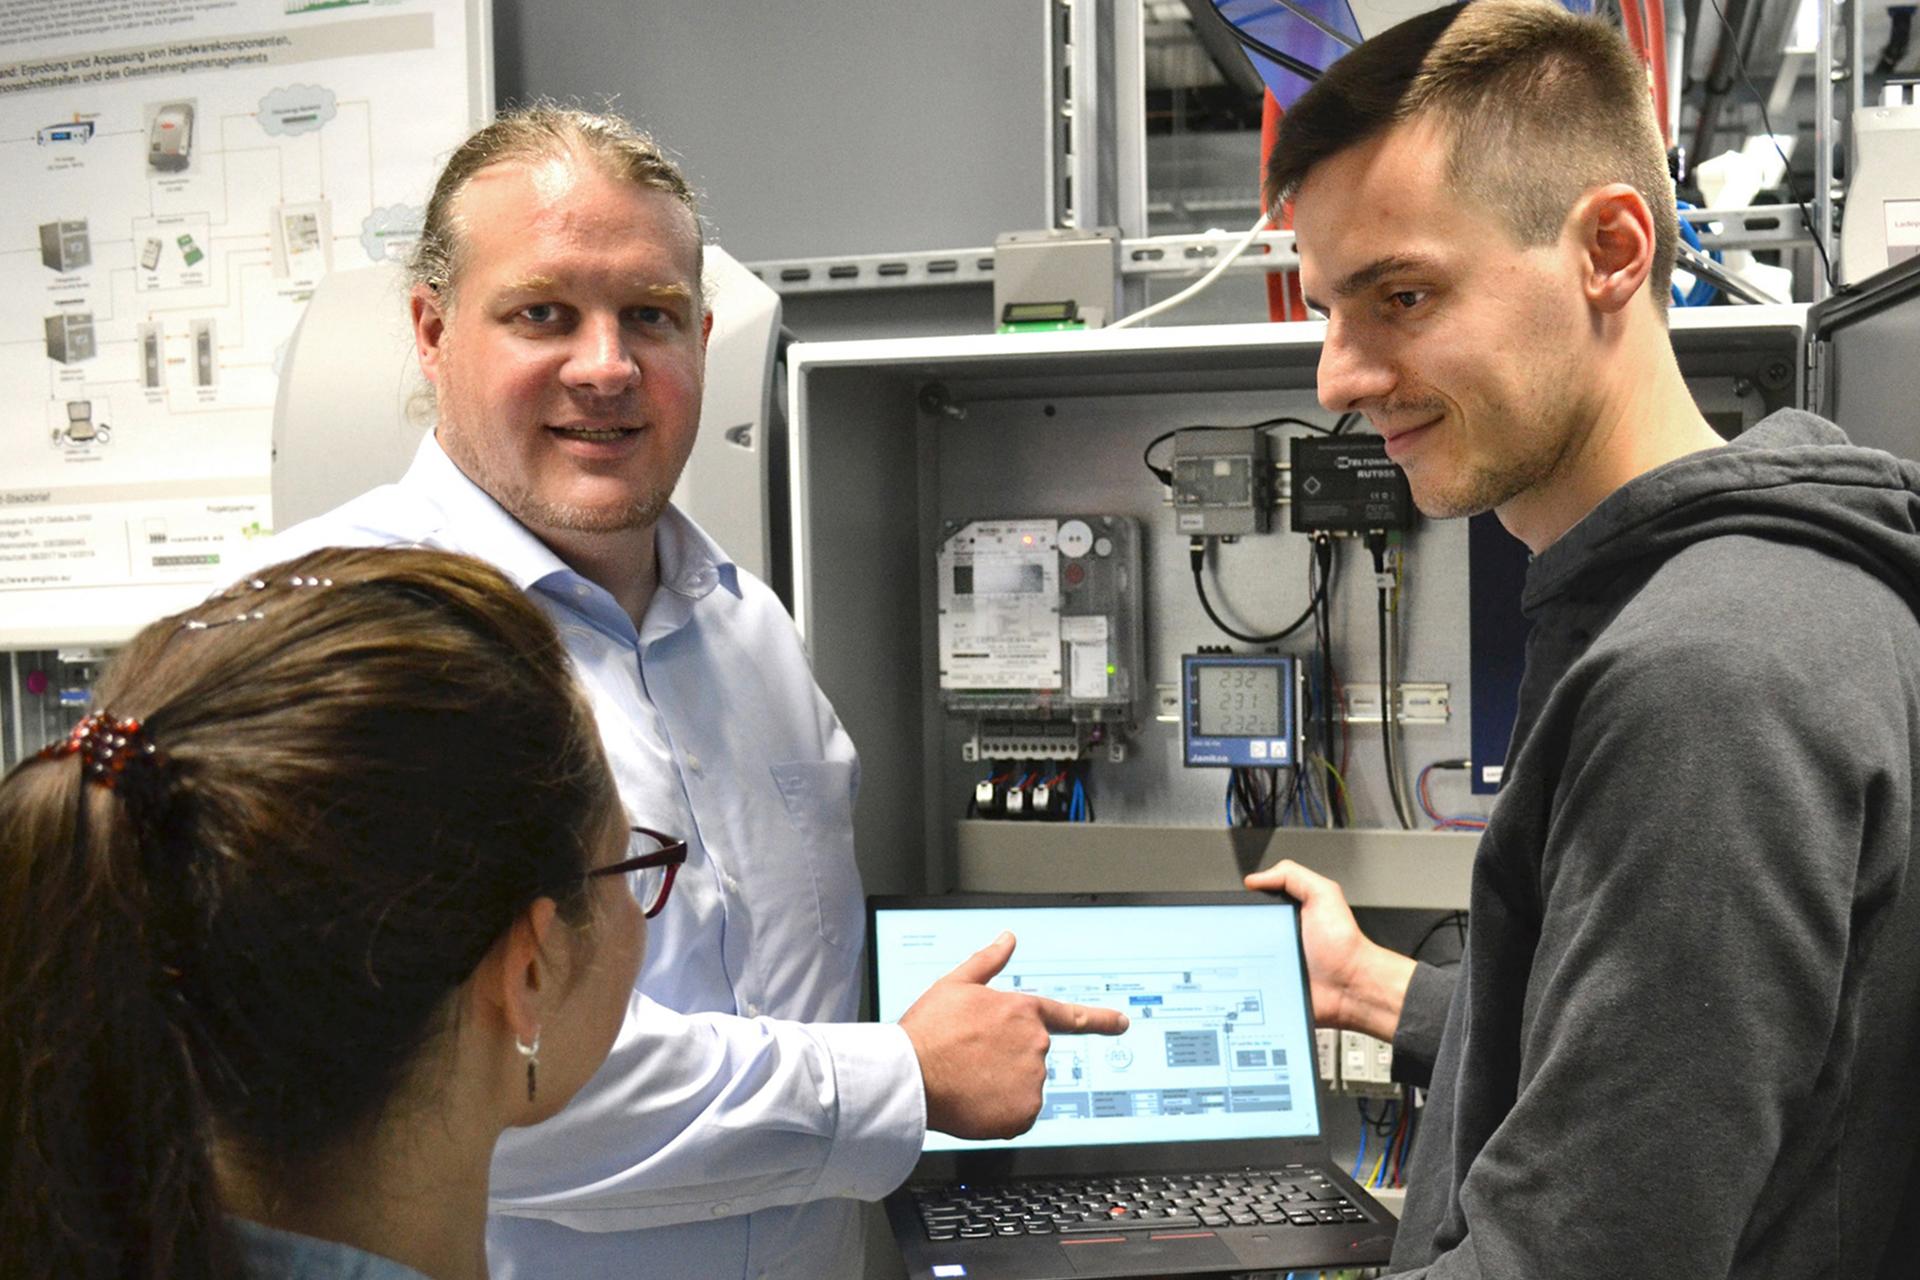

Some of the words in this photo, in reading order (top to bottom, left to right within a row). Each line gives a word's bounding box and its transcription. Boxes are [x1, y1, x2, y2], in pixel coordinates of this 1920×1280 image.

[21, 60, 70, 77] Erprobung
[72, 57, 91, 70] und
[93, 51, 146, 66] Anpassung
[148, 48, 166, 59] von
[82, 71, 102, 83] und
[1220, 670, 1258, 689] 232
[1219, 692, 1258, 711] 231
[1220, 714, 1258, 733] 232
